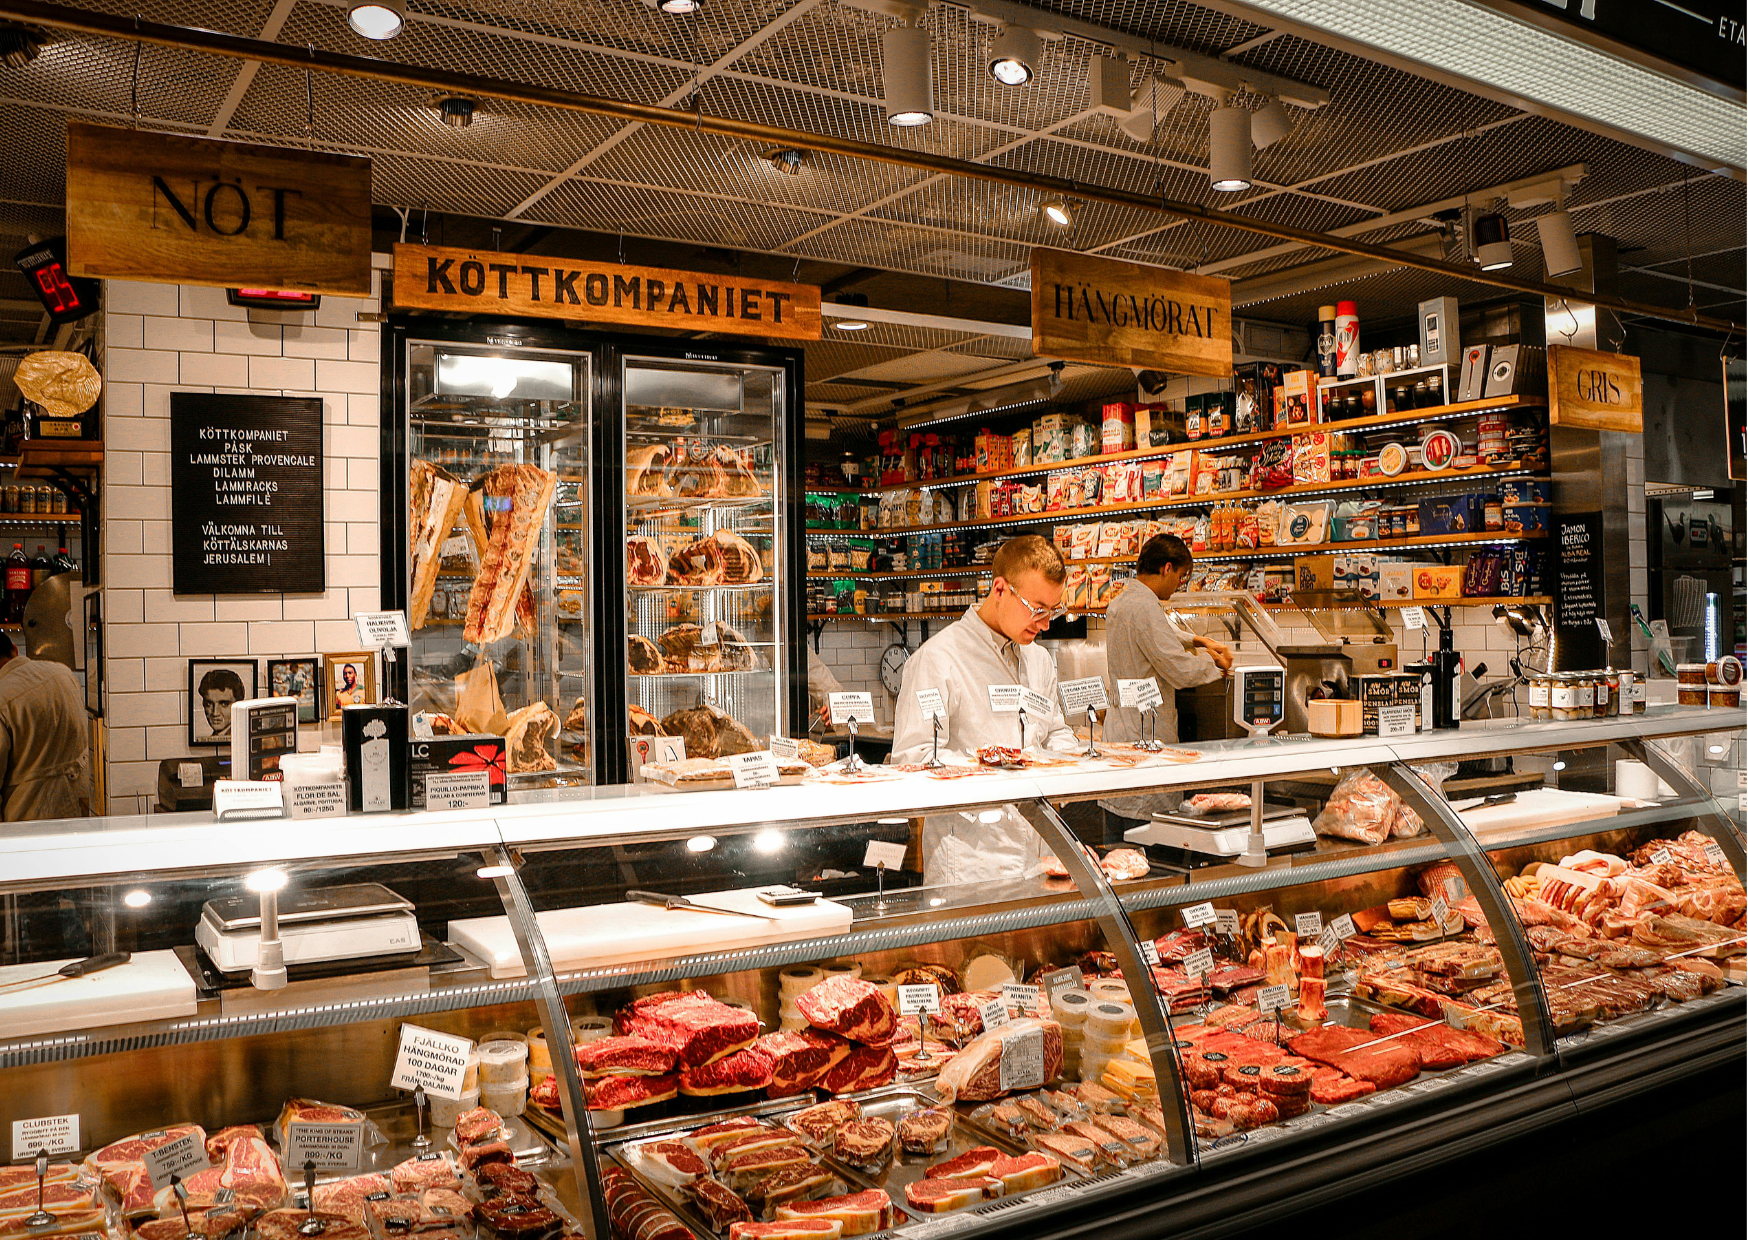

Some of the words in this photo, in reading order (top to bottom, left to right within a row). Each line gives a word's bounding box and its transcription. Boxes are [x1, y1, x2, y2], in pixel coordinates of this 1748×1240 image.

[151, 174, 303, 241] NÖT
[425, 254, 791, 325] KÖTTKOMPANIET
[1054, 281, 1218, 338] HÄNGMÖRAT
[1577, 369, 1621, 404] GRIS
[199, 426, 289, 441] KÖTTKOMPANIET
[190, 453, 246, 465] LAMMSTEK
[251, 454, 316, 466] PROVENCALE
[213, 467, 255, 479] DILAMM
[215, 480, 279, 492] LAMMRACKS
[202, 521, 256, 536] VÄLKOMNA
[261, 525, 284, 536] TILL
[203, 537, 288, 551] KÖTTÄLSKARNAS
[1561, 533, 1590, 545] IBERICO
[411, 744, 429, 758] LC
[414, 1036, 459, 1054] FJÄLLKO
[403, 1045, 465, 1066] HÄNGMÖRAD
[407, 1057, 423, 1068] 100
[424, 1061, 457, 1076] DAGAR
[422, 1080, 455, 1093] DALARNA
[22, 1117, 69, 1129] CLUBSTEK
[295, 1135, 355, 1144] PORTERHOUSE
[152, 1136, 193, 1159] T-BENSTEK
